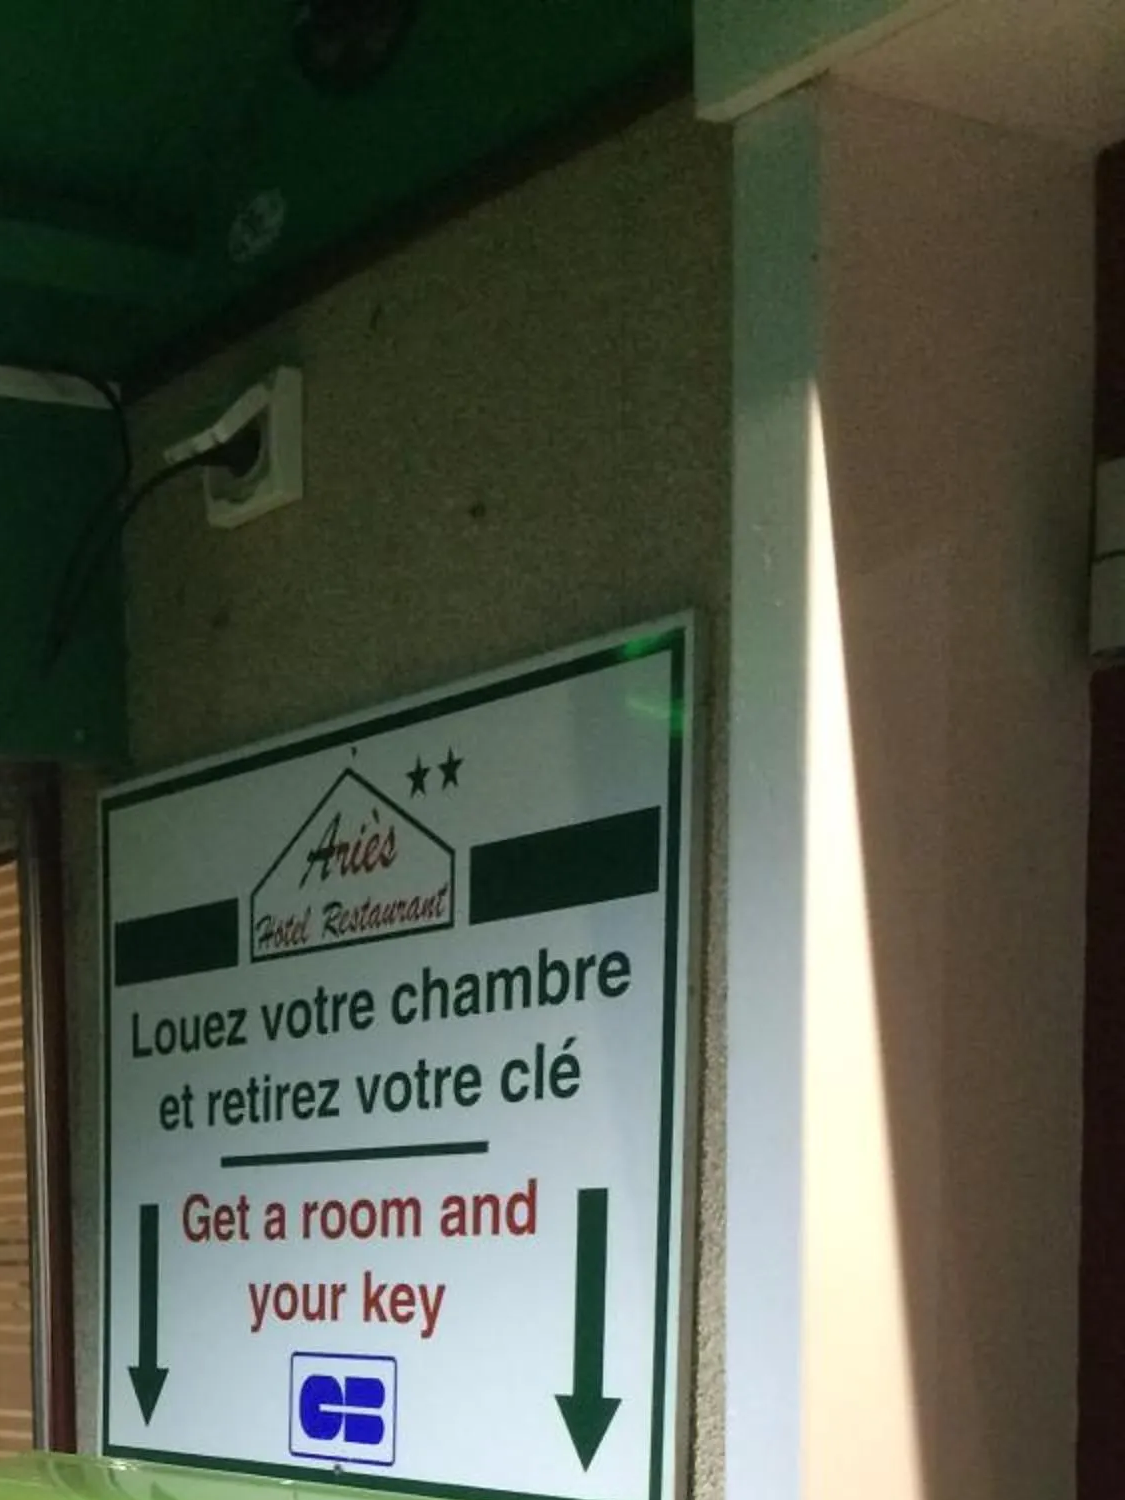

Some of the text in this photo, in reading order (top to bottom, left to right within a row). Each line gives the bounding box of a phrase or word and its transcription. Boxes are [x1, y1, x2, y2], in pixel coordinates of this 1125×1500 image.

[256, 883, 448, 950] Hotel Restaurant
[132, 948, 631, 1058] Louez votre chambre
[159, 1037, 581, 1130] et retirez votre clé
[182, 1178, 537, 1242] Get a room and
[249, 1271, 445, 1339] your key
